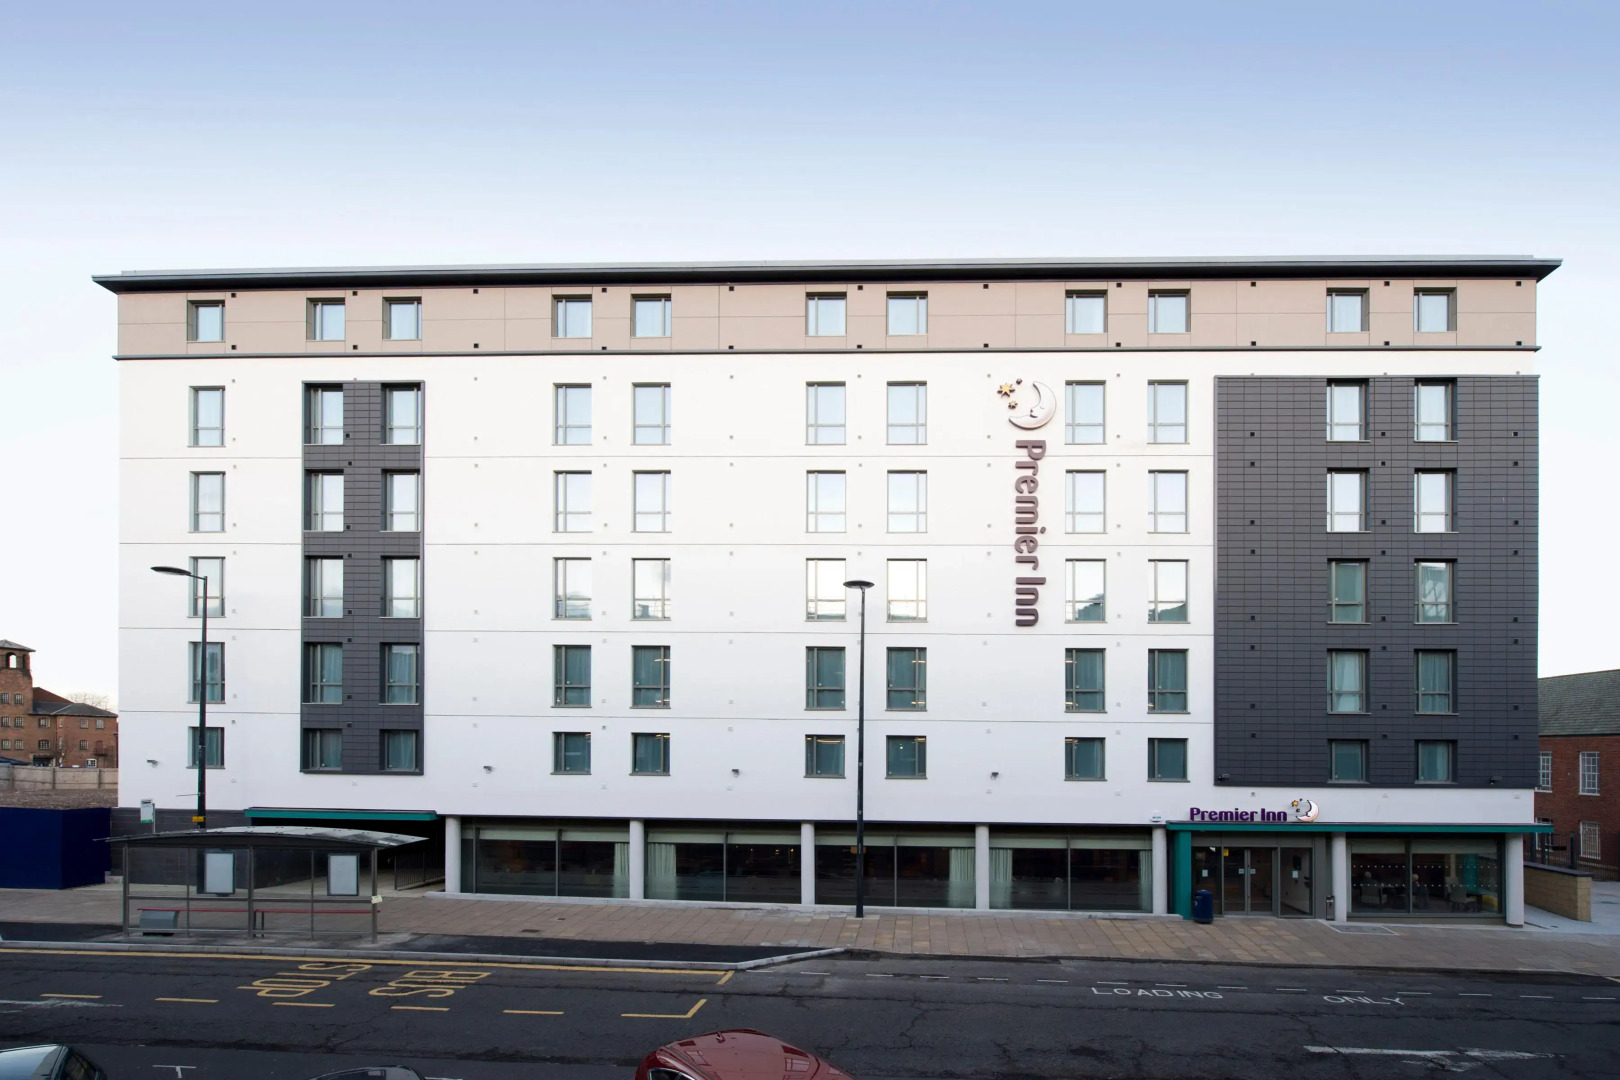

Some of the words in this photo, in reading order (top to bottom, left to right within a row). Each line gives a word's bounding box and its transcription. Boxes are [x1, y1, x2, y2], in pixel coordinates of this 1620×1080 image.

[1015, 439, 1047, 571] Premier
[1015, 576, 1047, 627] Inn
[1189, 807, 1258, 822] Premier
[1260, 808, 1287, 822] Inn
[236, 963, 373, 998] STOP
[368, 970, 493, 998] BUS
[1091, 987, 1224, 1000] LOADING
[1323, 995, 1405, 1006] ONLY
